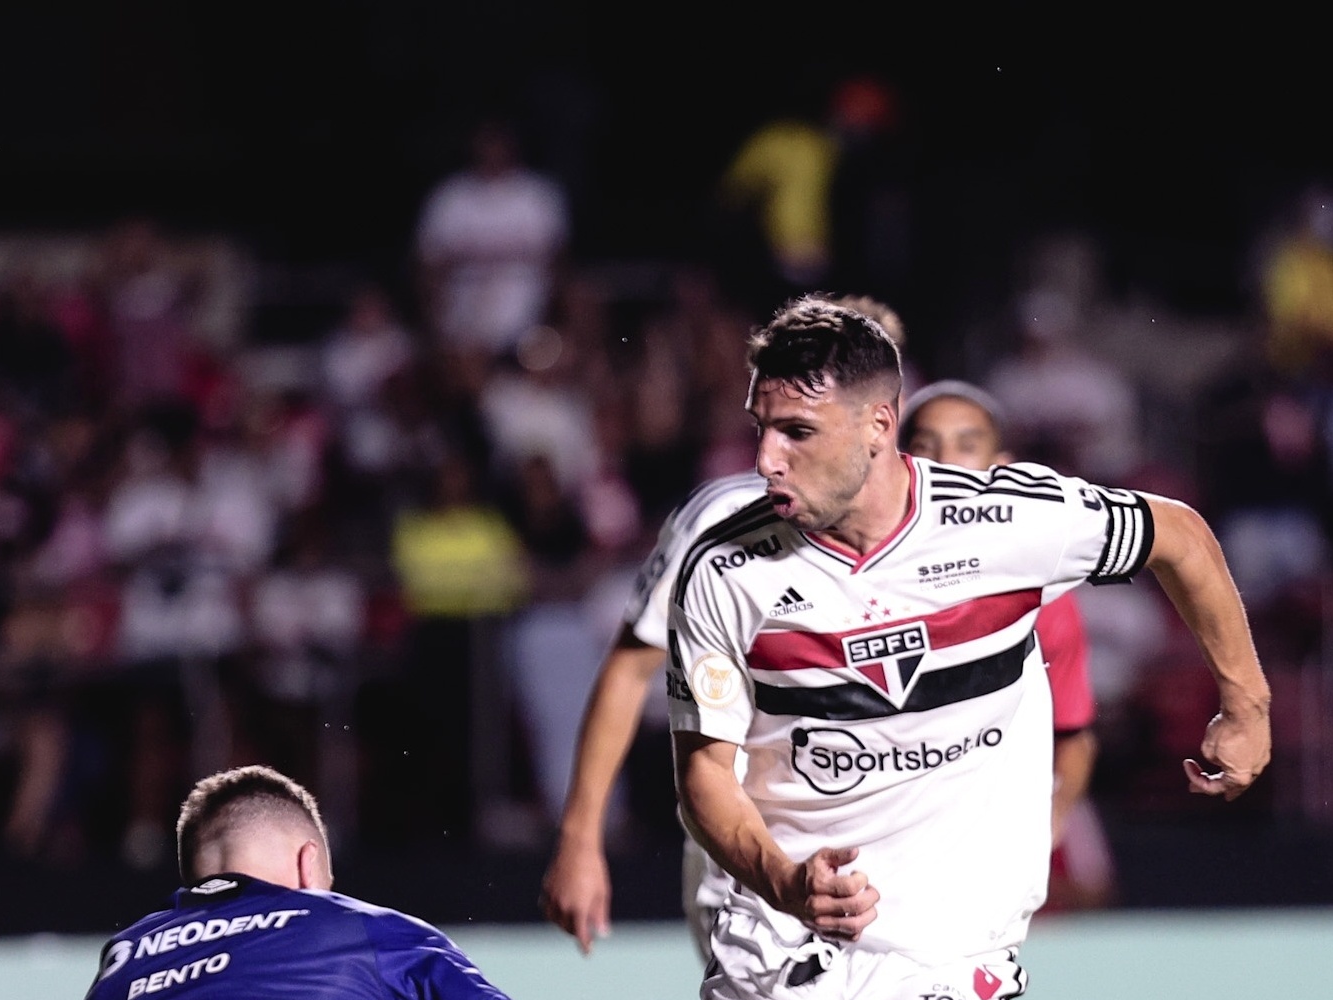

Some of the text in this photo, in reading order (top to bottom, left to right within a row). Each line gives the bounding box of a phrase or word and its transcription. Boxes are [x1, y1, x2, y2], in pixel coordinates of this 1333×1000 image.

[918, 557, 980, 576] $SPFC
[769, 601, 814, 617] adidas
[849, 632, 924, 662] SPFC
[133, 909, 301, 959] NEODENT
[127, 952, 231, 1000] BENTO
